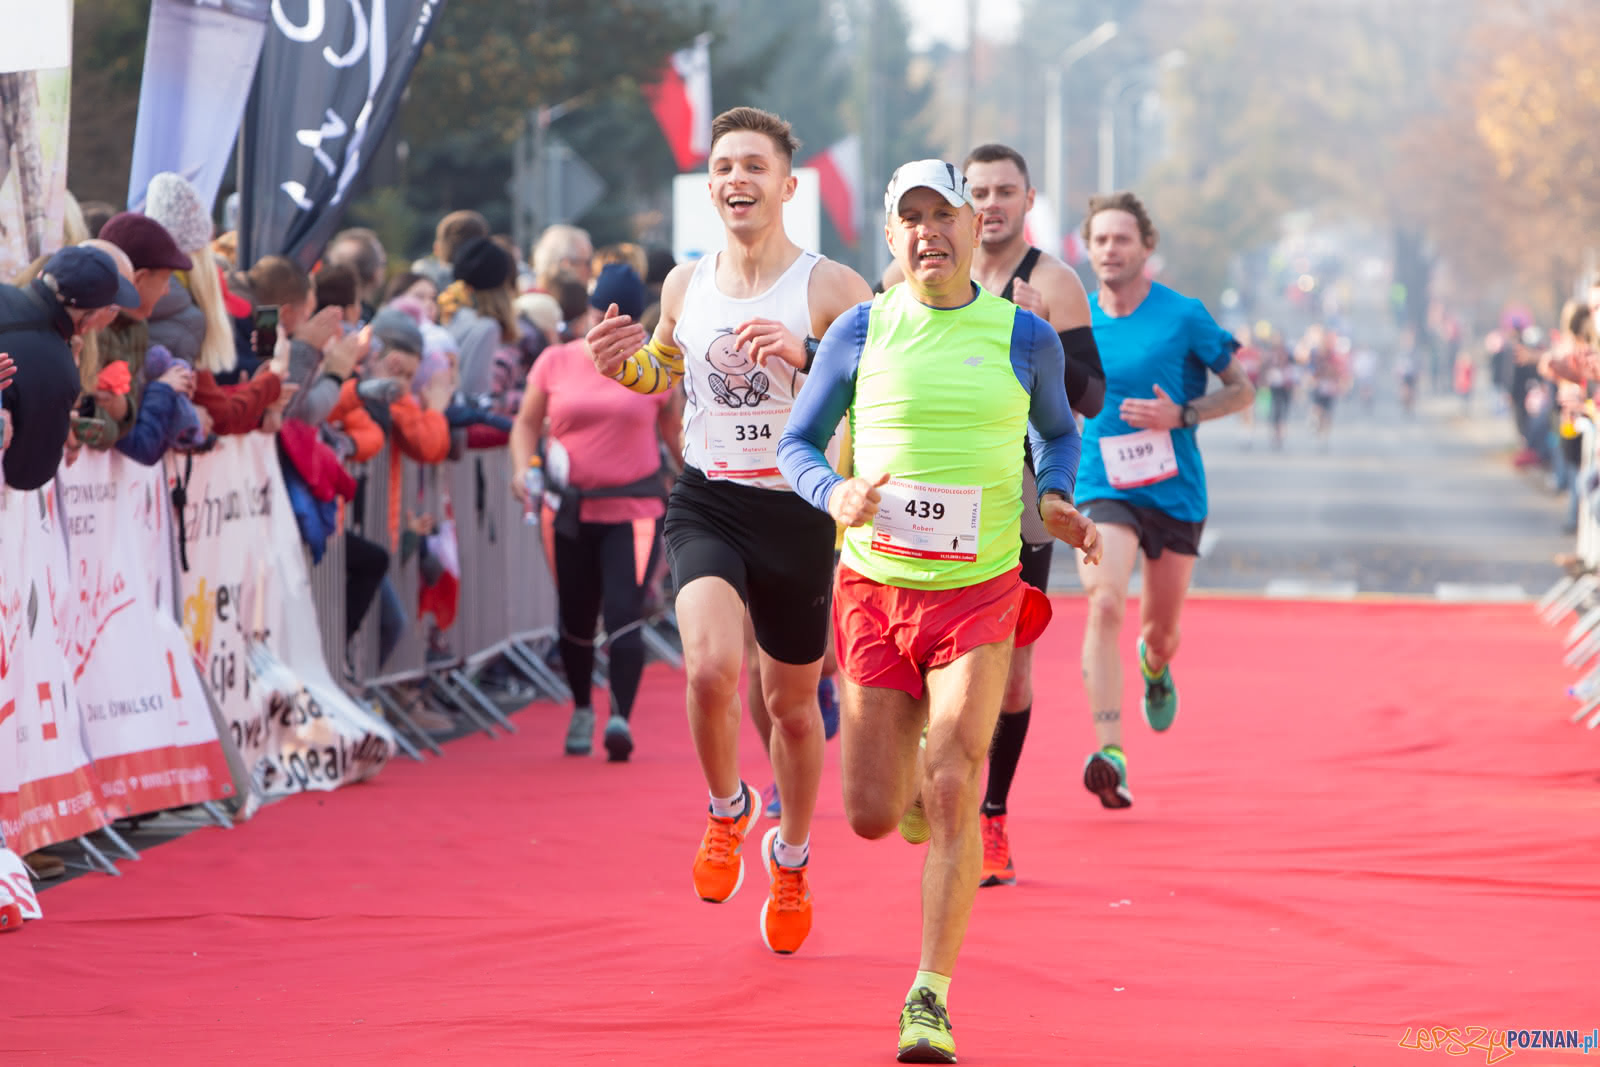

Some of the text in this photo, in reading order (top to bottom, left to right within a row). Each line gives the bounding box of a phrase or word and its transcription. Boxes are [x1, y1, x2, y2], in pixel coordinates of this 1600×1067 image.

[735, 424, 772, 441] 334
[1118, 442, 1154, 462] 1199
[913, 484, 927, 492] BIEG
[927, 487, 977, 495] NIEPODLEGŁOŚCI
[904, 499, 945, 520] 439
[912, 524, 934, 532] Robert
